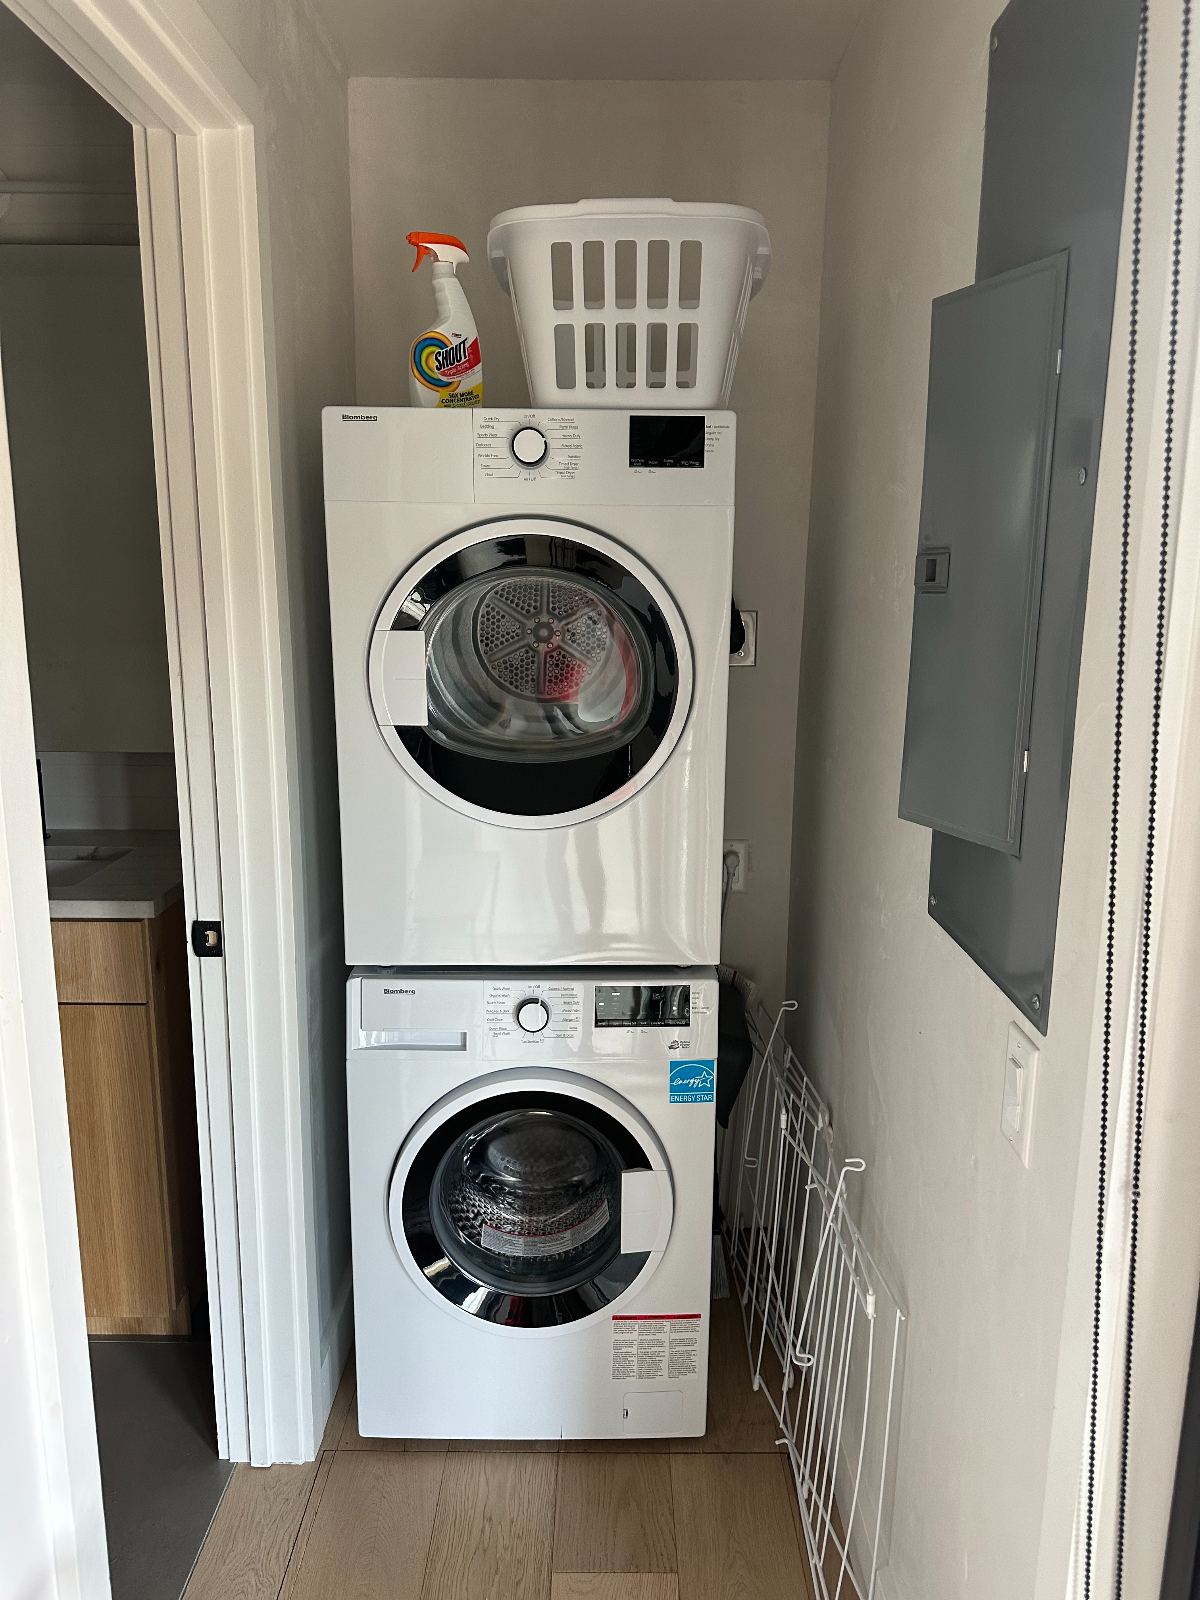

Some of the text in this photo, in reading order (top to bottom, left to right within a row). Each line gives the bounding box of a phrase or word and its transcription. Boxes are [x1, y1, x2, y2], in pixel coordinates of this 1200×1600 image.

[434, 337, 468, 371] SHOUT
[441, 394, 480, 404] CONCENTRATED
[341, 414, 378, 422] Blomberg
[383, 988, 416, 996] Blomberg
[696, 1094, 713, 1102] STAR
